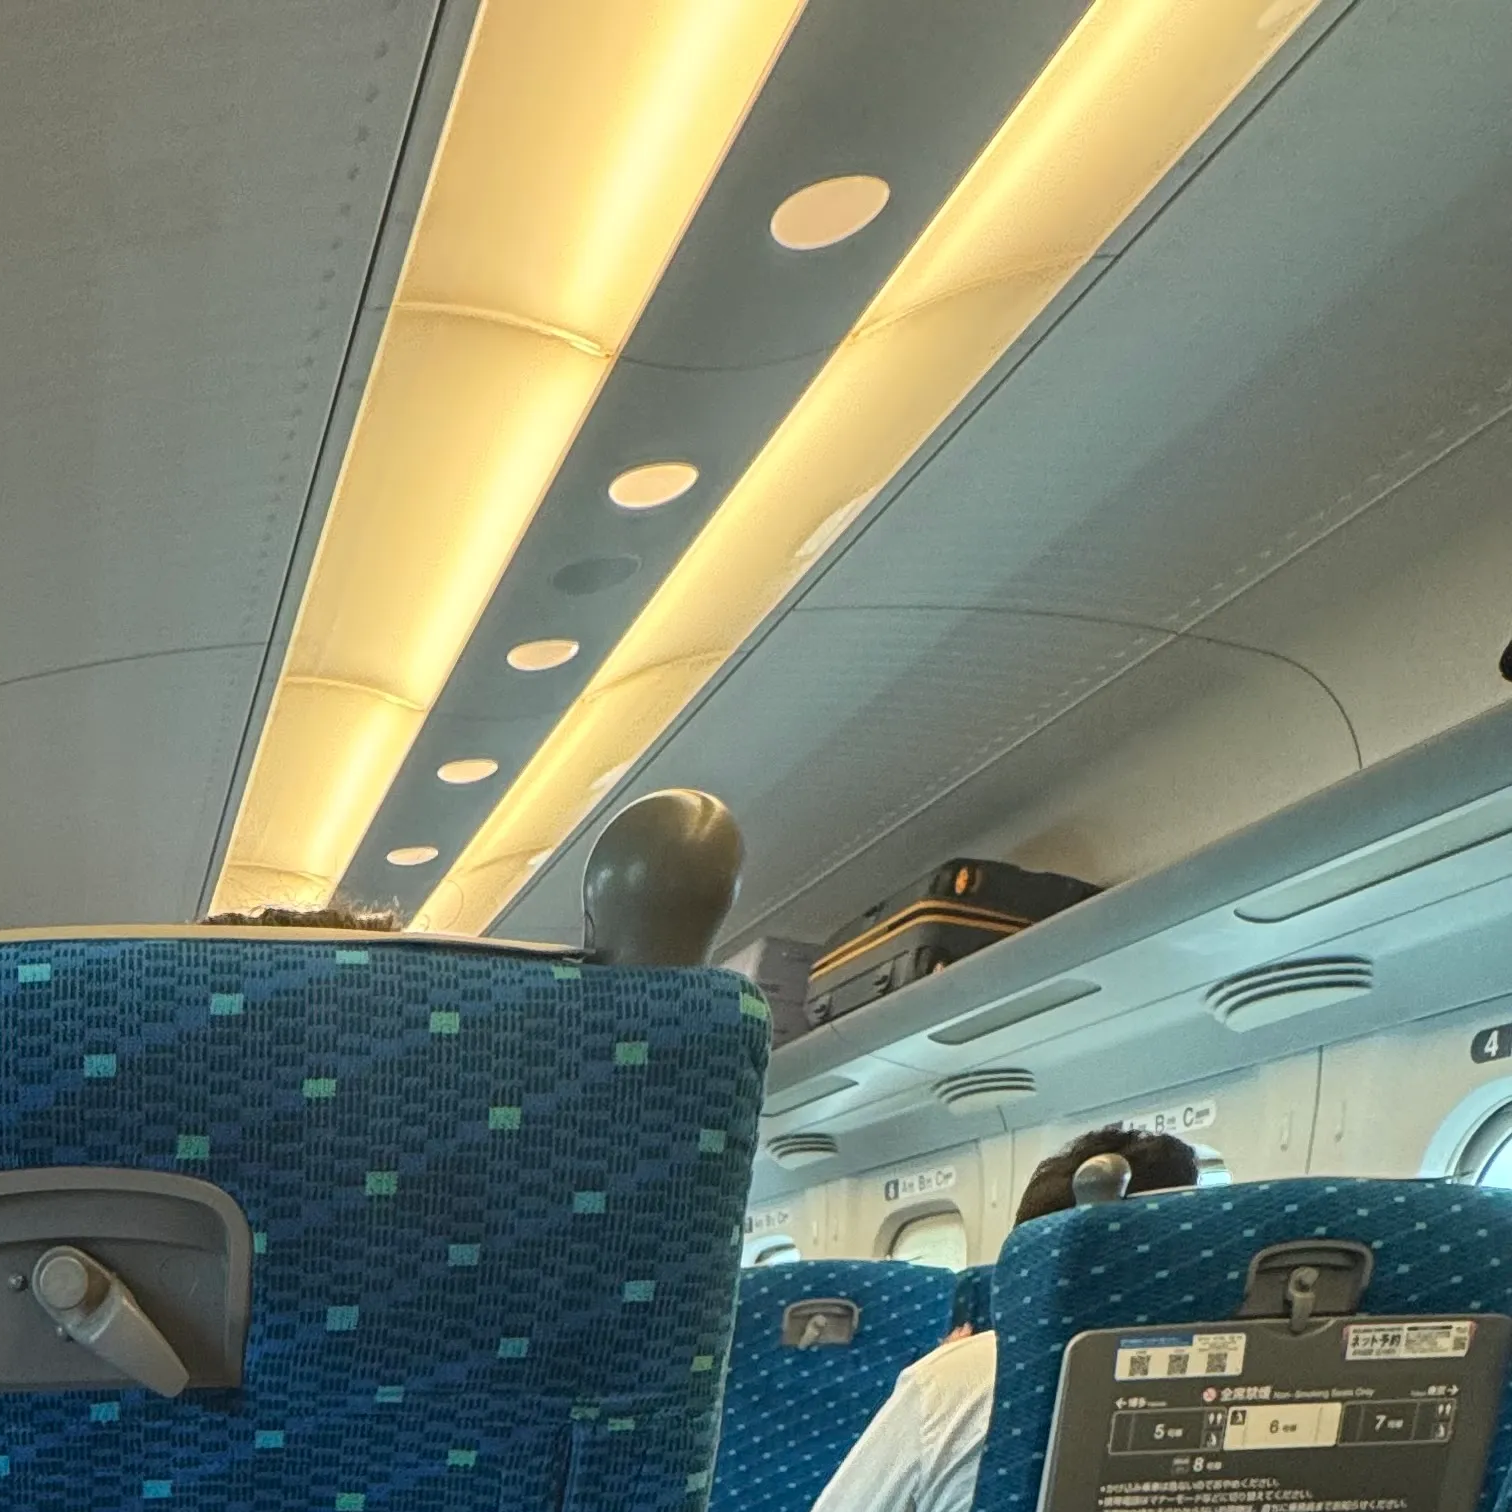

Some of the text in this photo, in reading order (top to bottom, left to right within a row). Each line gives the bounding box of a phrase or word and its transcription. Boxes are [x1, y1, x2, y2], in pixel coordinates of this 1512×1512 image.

[1484, 1030, 1499, 1057] 4
[1269, 1420, 1280, 1434] 6
[1374, 1414, 1387, 1431] 7
[1153, 1423, 1166, 1440] 5
[1192, 1456, 1205, 1472] 8
